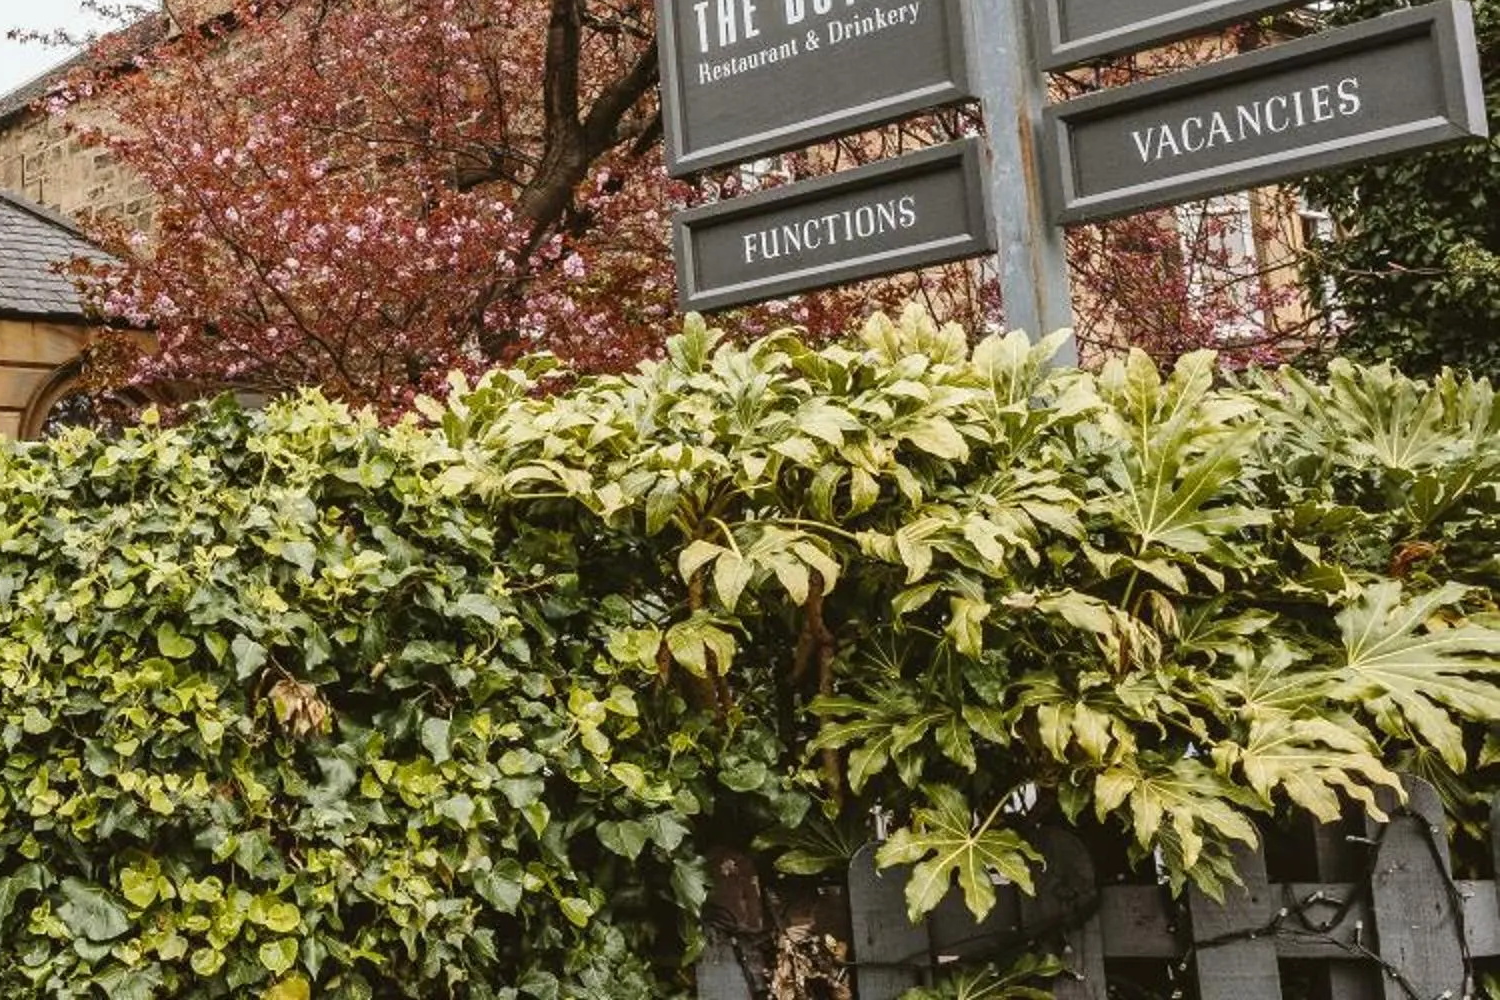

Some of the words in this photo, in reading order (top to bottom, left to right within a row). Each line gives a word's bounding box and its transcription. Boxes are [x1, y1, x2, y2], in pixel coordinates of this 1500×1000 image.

[699, 39, 799, 85] Restaurant
[805, 29, 821, 51] &
[827, 1, 920, 45] Drinkery
[1132, 77, 1362, 163] VACANCIES
[742, 195, 916, 264] FUNCTIONS
